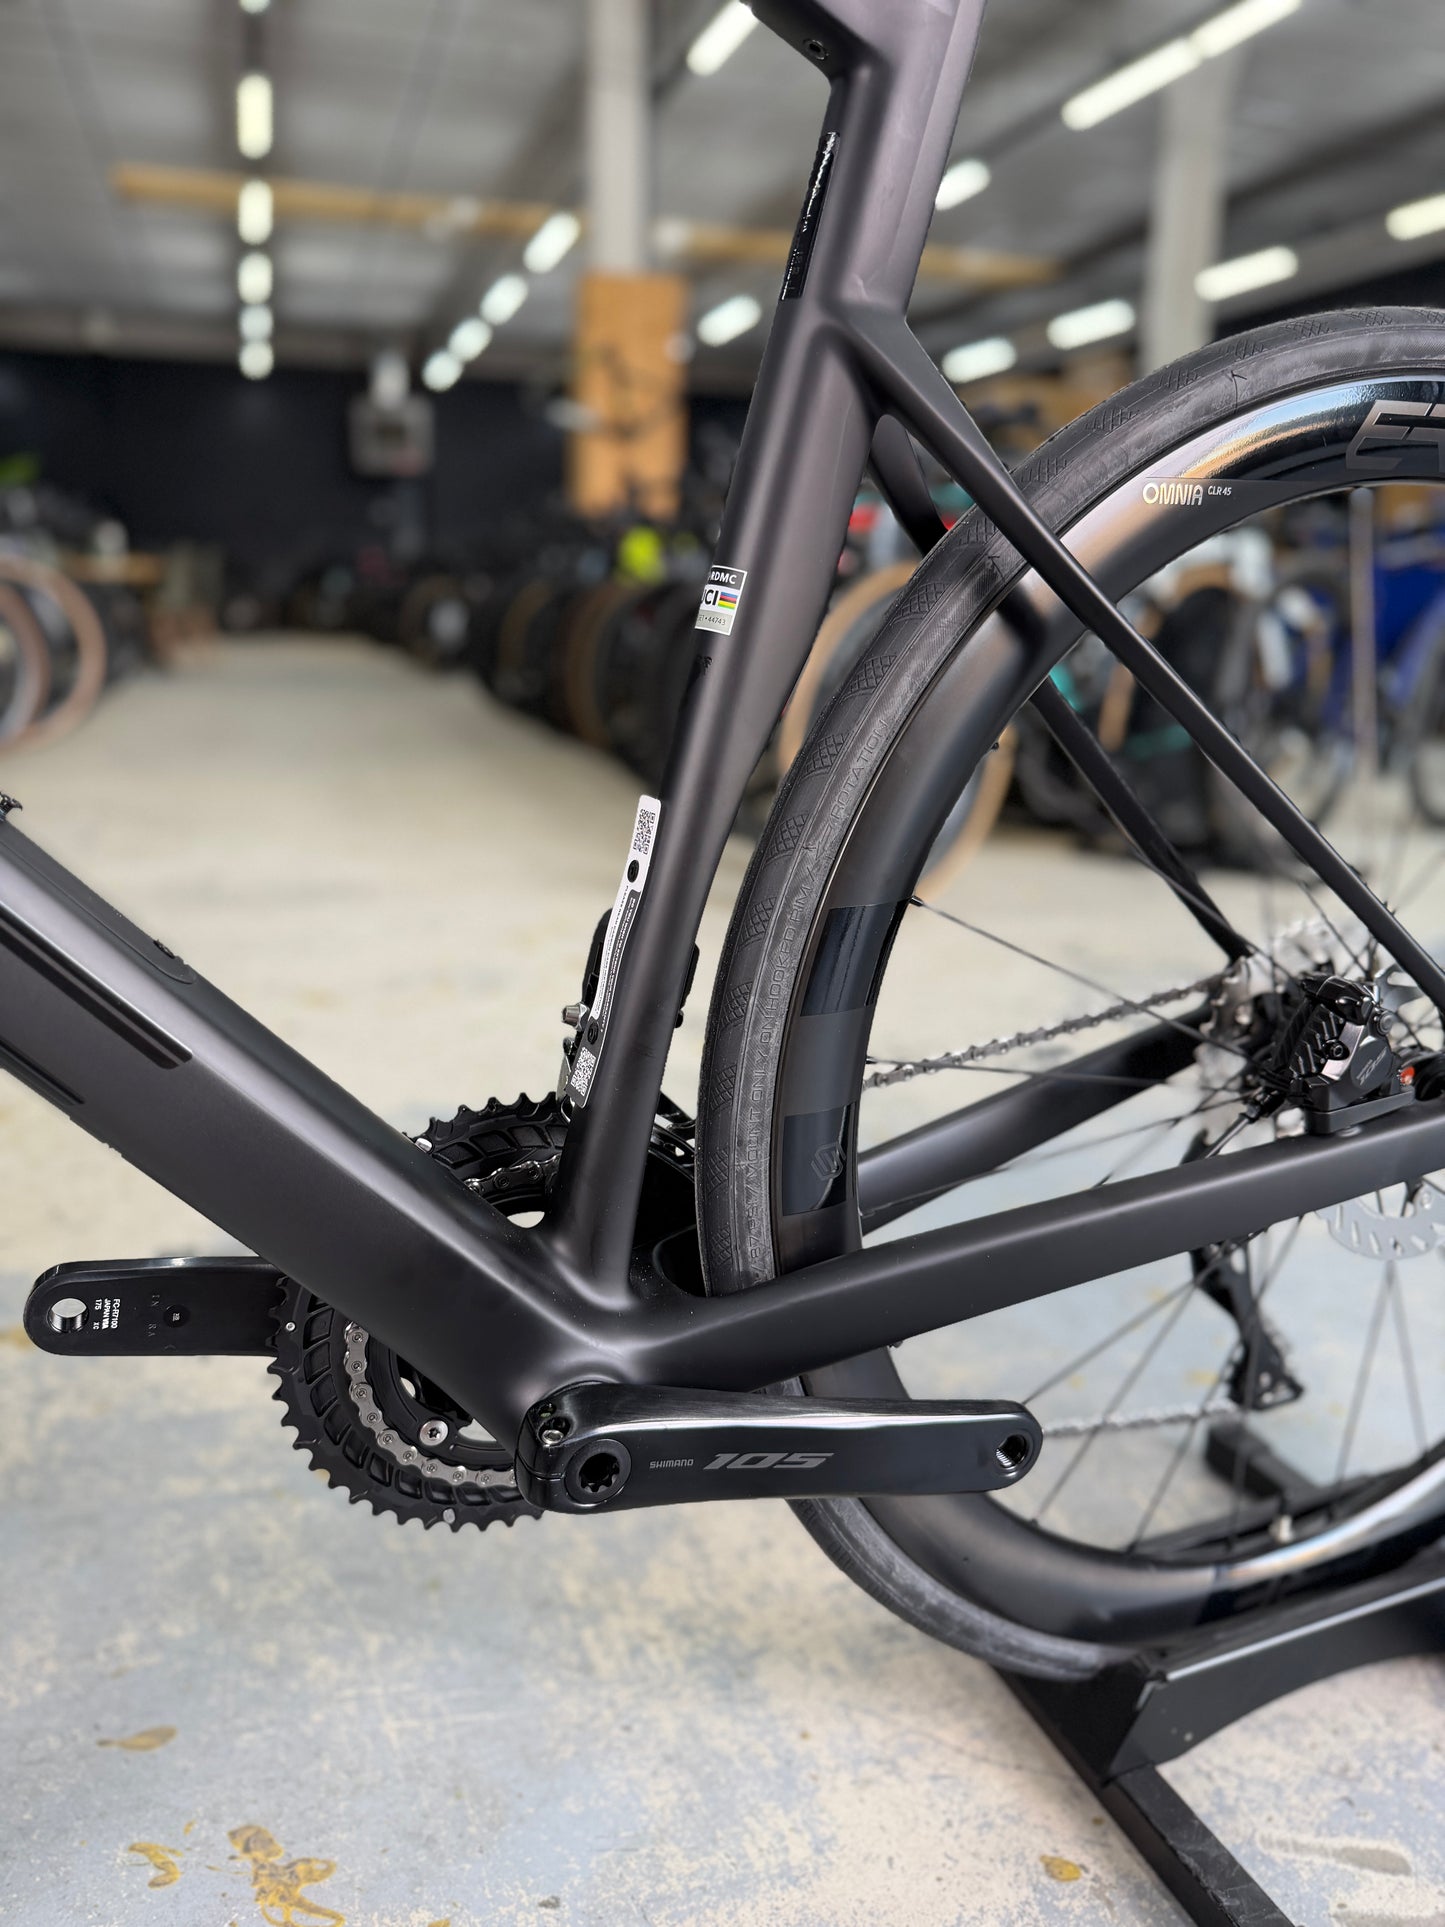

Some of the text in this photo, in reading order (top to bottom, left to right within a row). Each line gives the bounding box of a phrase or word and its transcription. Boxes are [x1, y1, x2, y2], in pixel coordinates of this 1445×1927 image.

[1142, 482, 1204, 506] OMNIA
[702, 588, 719, 606] CI
[830, 719, 889, 820] ROTATION
[650, 1452, 835, 1470] SHIMANO 105
